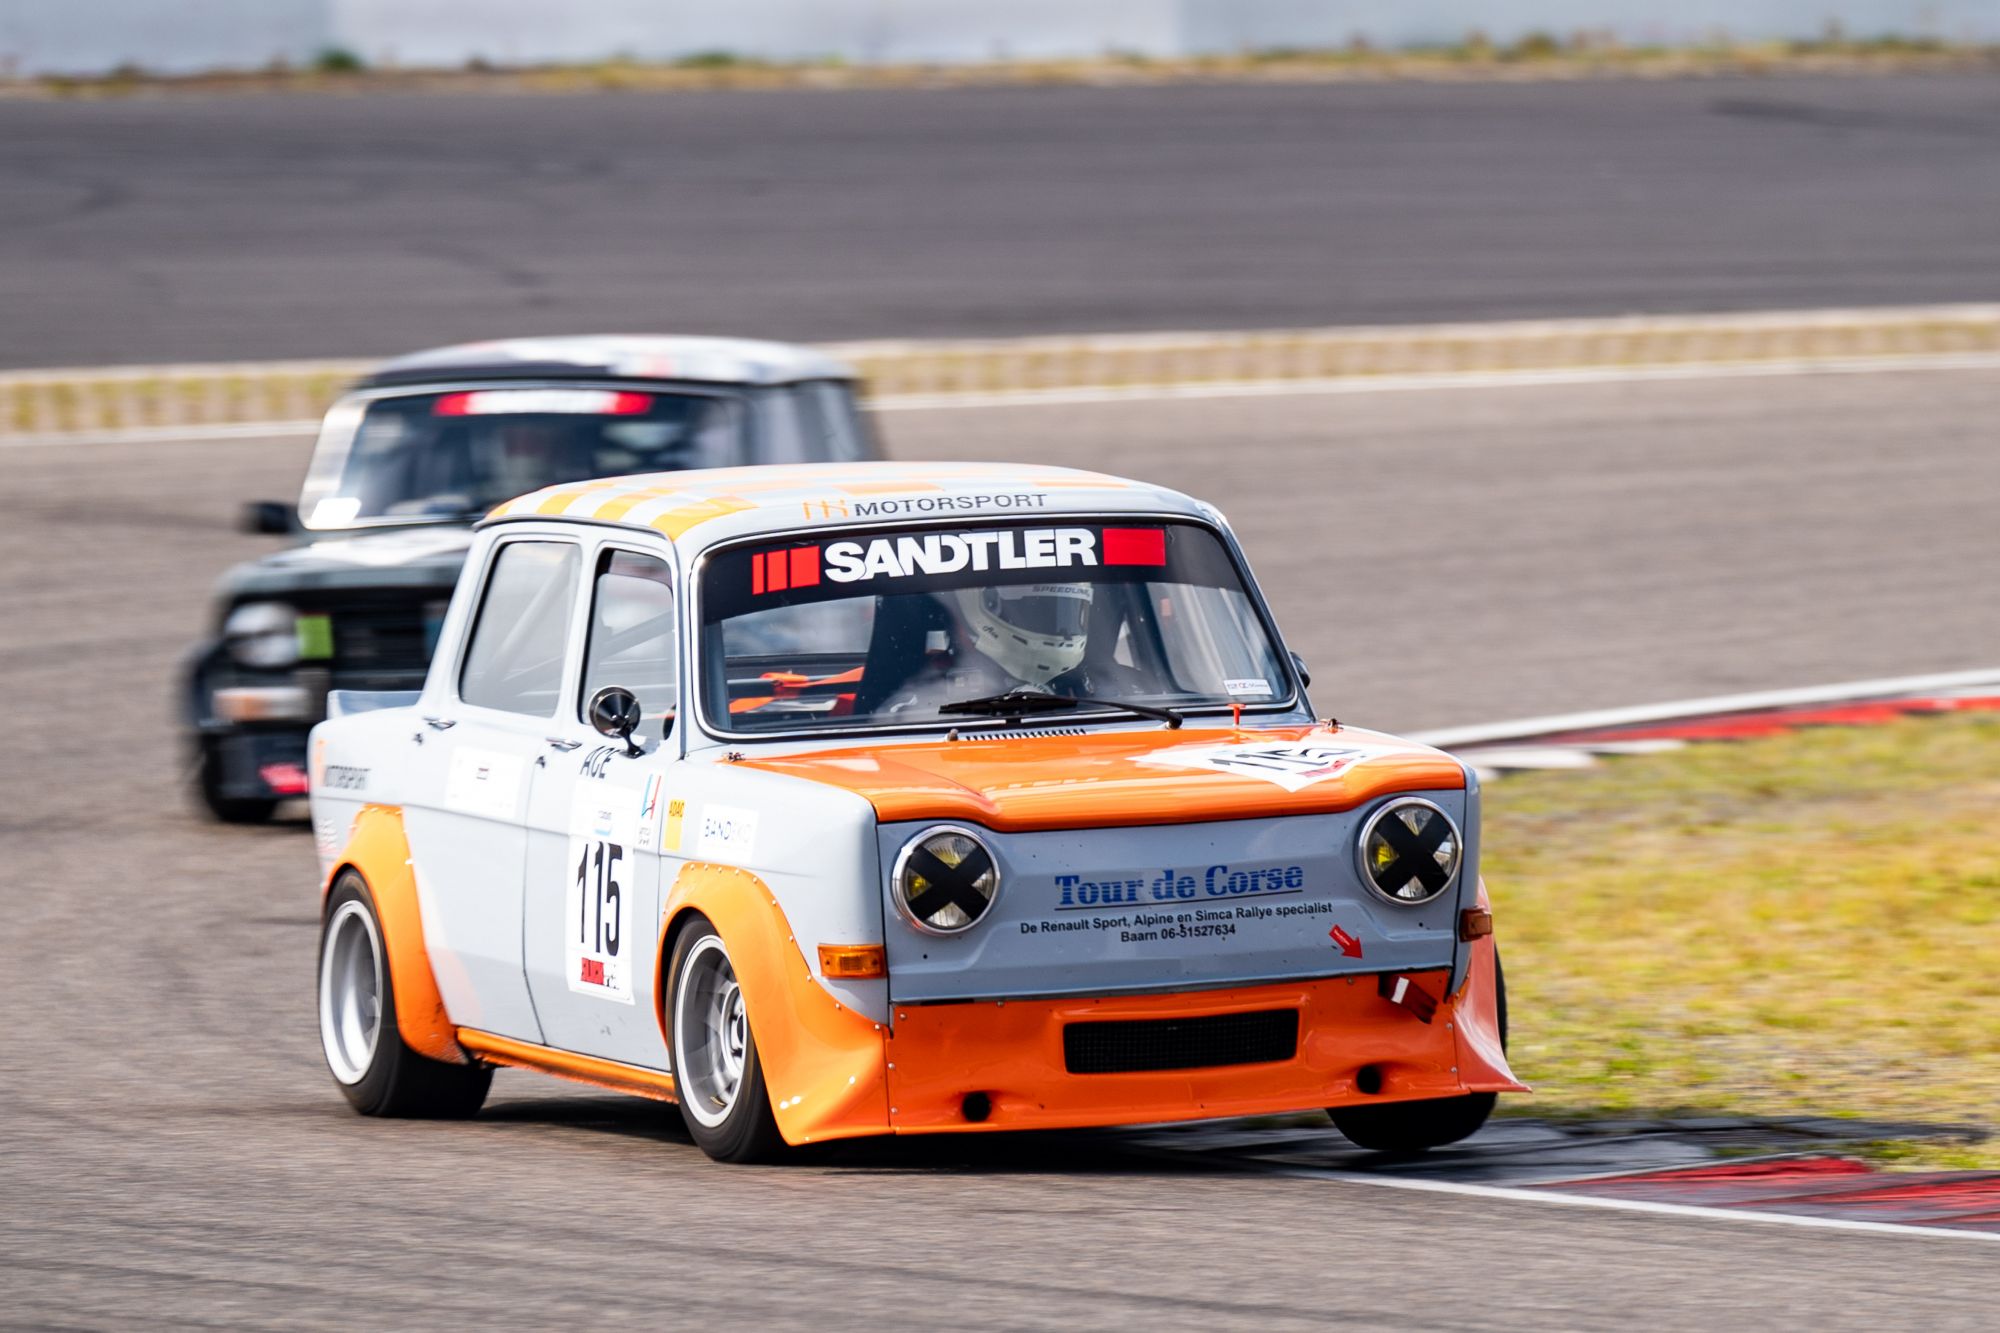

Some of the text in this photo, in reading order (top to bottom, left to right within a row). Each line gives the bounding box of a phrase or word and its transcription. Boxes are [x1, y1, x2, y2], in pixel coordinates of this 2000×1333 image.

[854, 494, 1048, 517] MOTORSPORT
[824, 528, 1098, 582] SANDTLER
[577, 840, 623, 956] 115
[1054, 865, 1303, 905] Tour de Corse
[1020, 902, 1333, 934] De Renault Sport, Alpine en Simca Rallye specialist
[1121, 923, 1236, 943] Baarn 06-51527634
